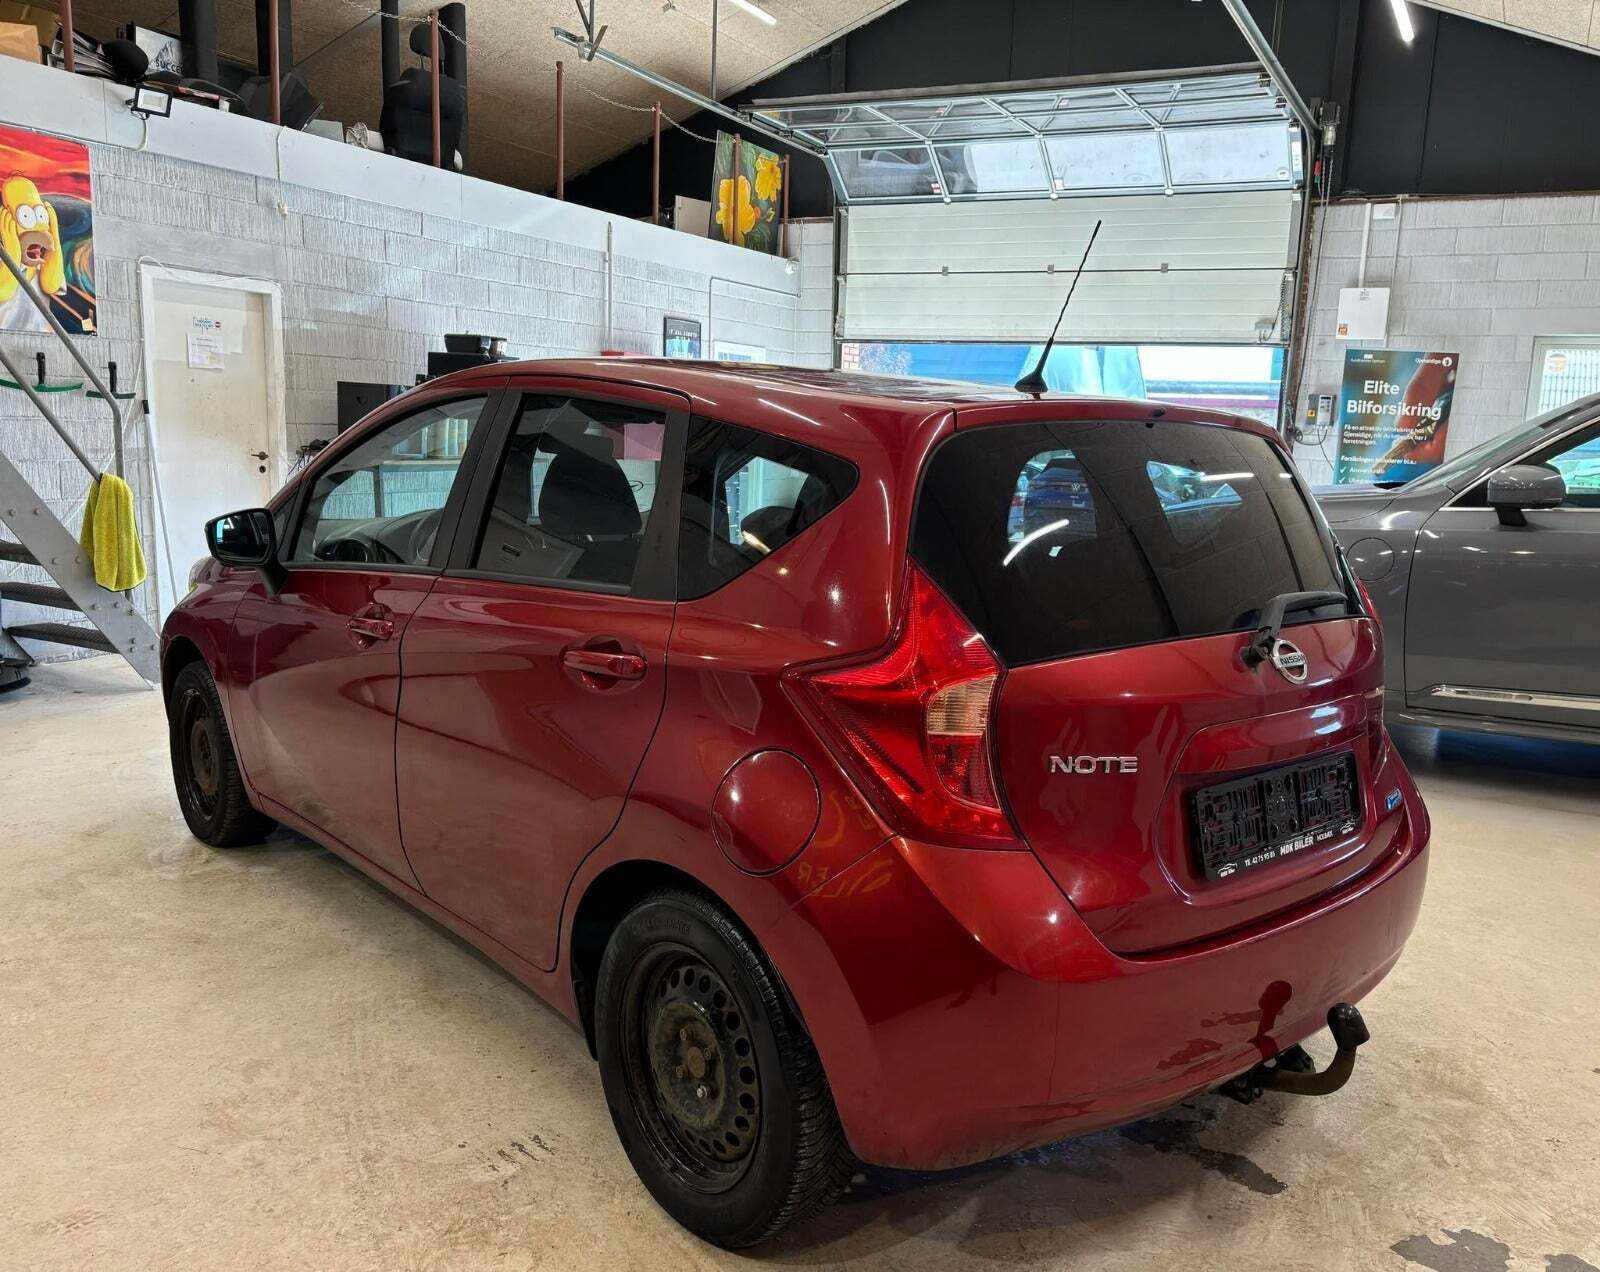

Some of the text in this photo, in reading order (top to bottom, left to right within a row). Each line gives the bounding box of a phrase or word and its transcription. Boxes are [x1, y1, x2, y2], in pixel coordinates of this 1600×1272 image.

[1363, 380, 1400, 395] Elite
[1346, 400, 1442, 420] Bilforsikring
[1050, 755, 1138, 774] NOTE
[1294, 836, 1314, 850] BILER
